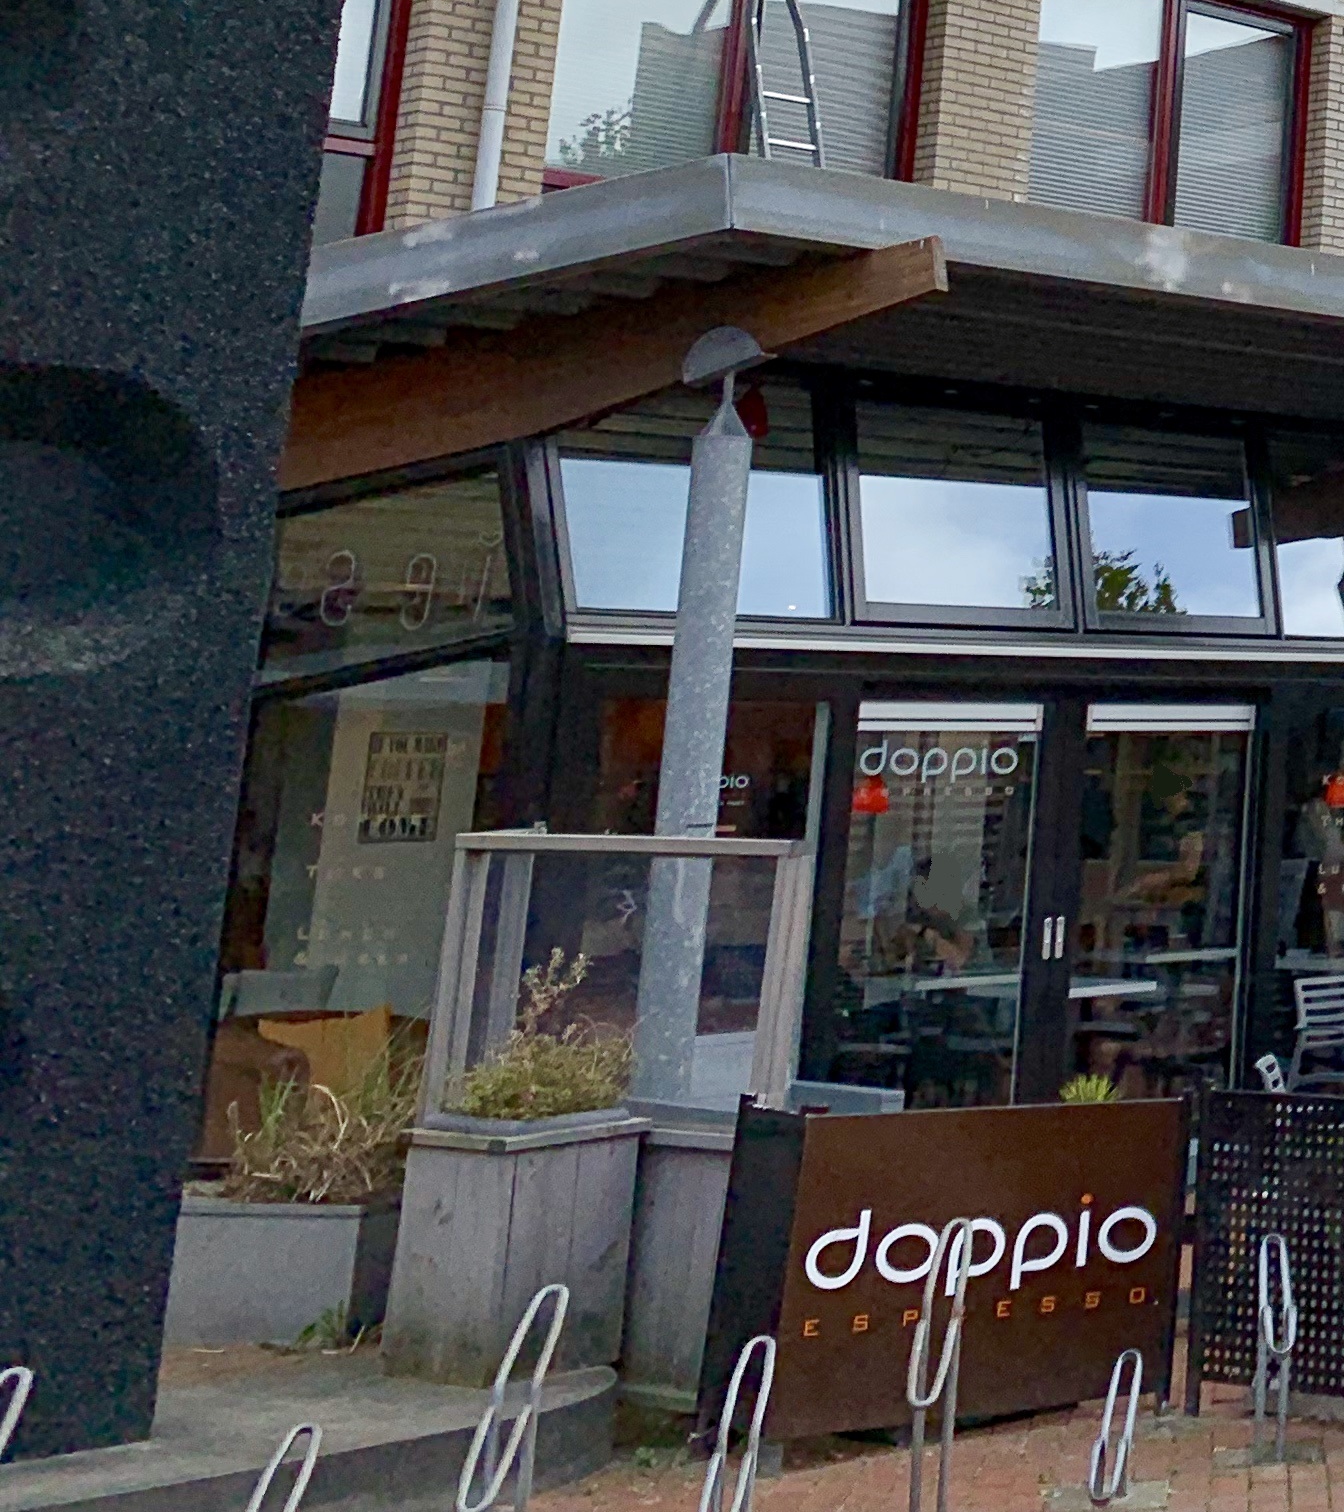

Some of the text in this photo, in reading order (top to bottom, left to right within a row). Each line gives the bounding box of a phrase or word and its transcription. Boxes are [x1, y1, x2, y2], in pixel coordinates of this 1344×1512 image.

[859, 739, 1018, 783] doppio
[1316, 882, 1327, 895] &
[804, 1192, 1157, 1297] doppio
[803, 1287, 1146, 1337] ESPESSO
